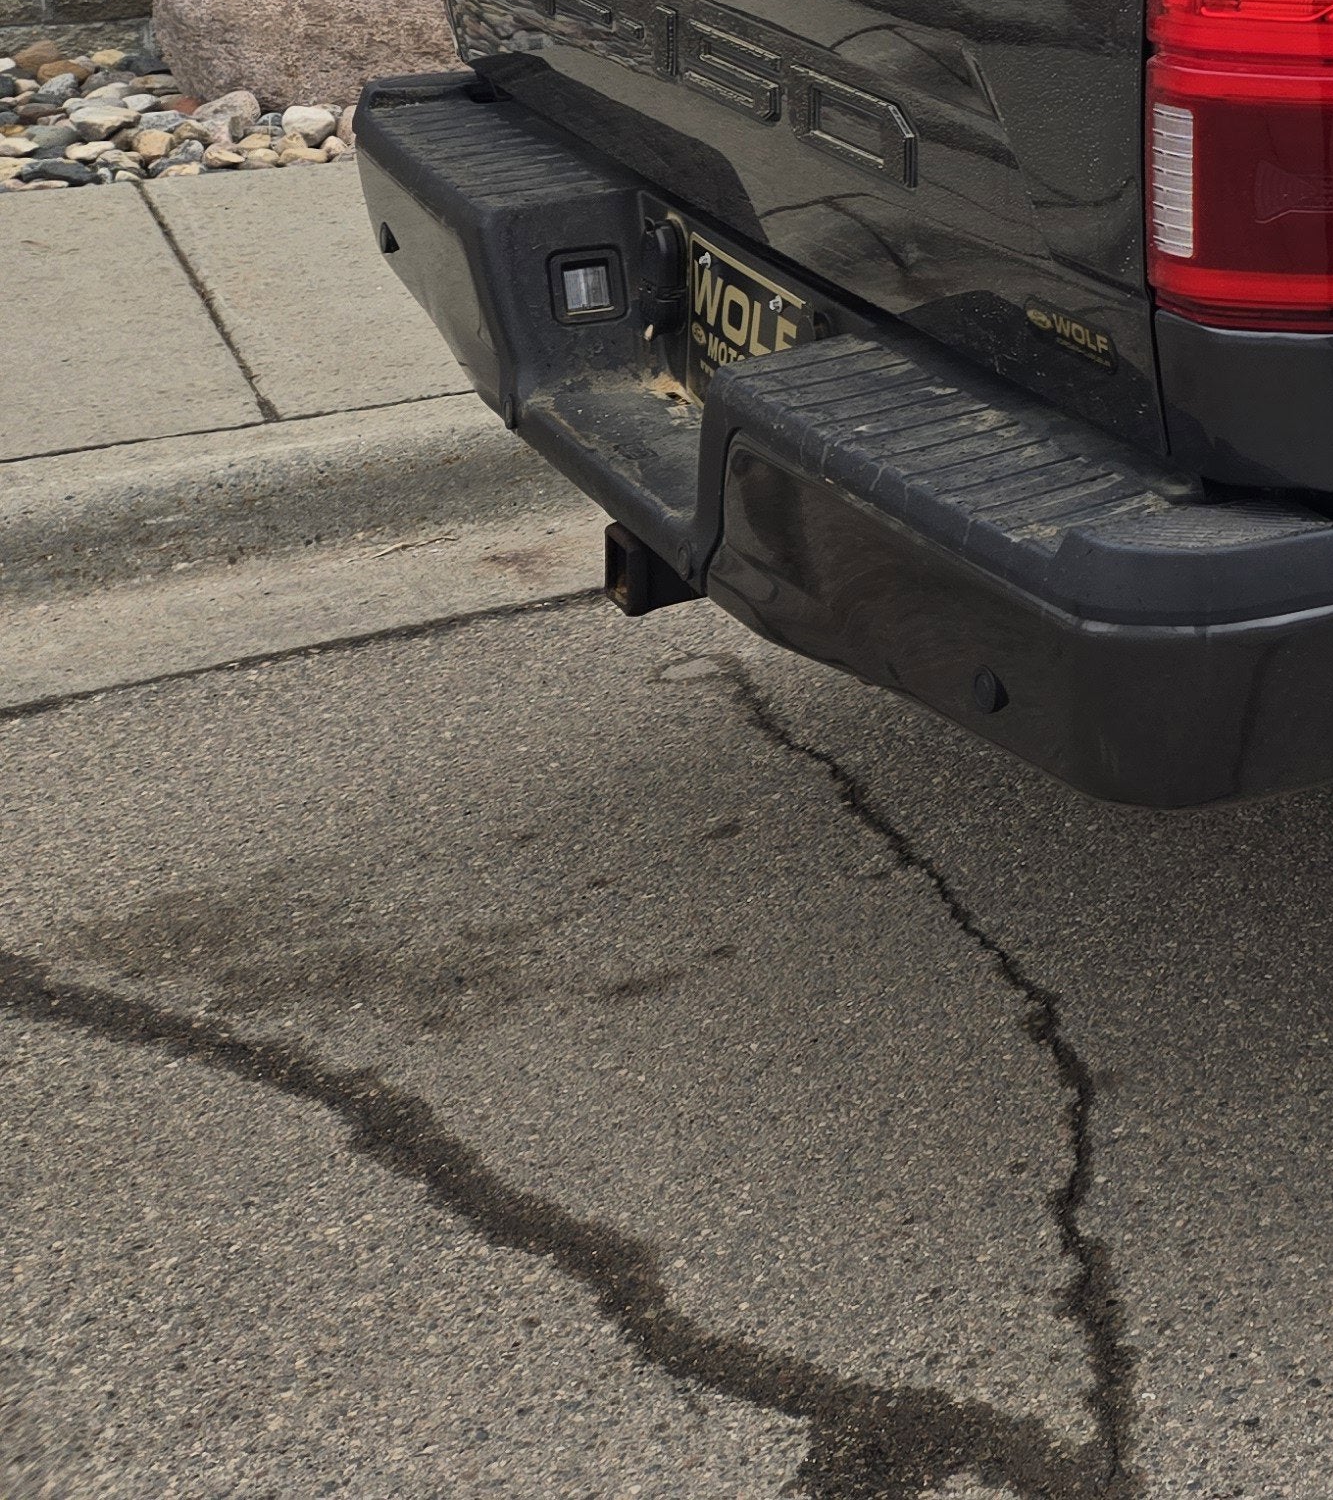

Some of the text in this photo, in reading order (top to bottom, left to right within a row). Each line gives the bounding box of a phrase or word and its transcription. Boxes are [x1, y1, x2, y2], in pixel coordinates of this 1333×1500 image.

[692, 258, 797, 357] WOLF
[707, 332, 746, 367] MOT
[1052, 312, 1109, 354] WOLF
